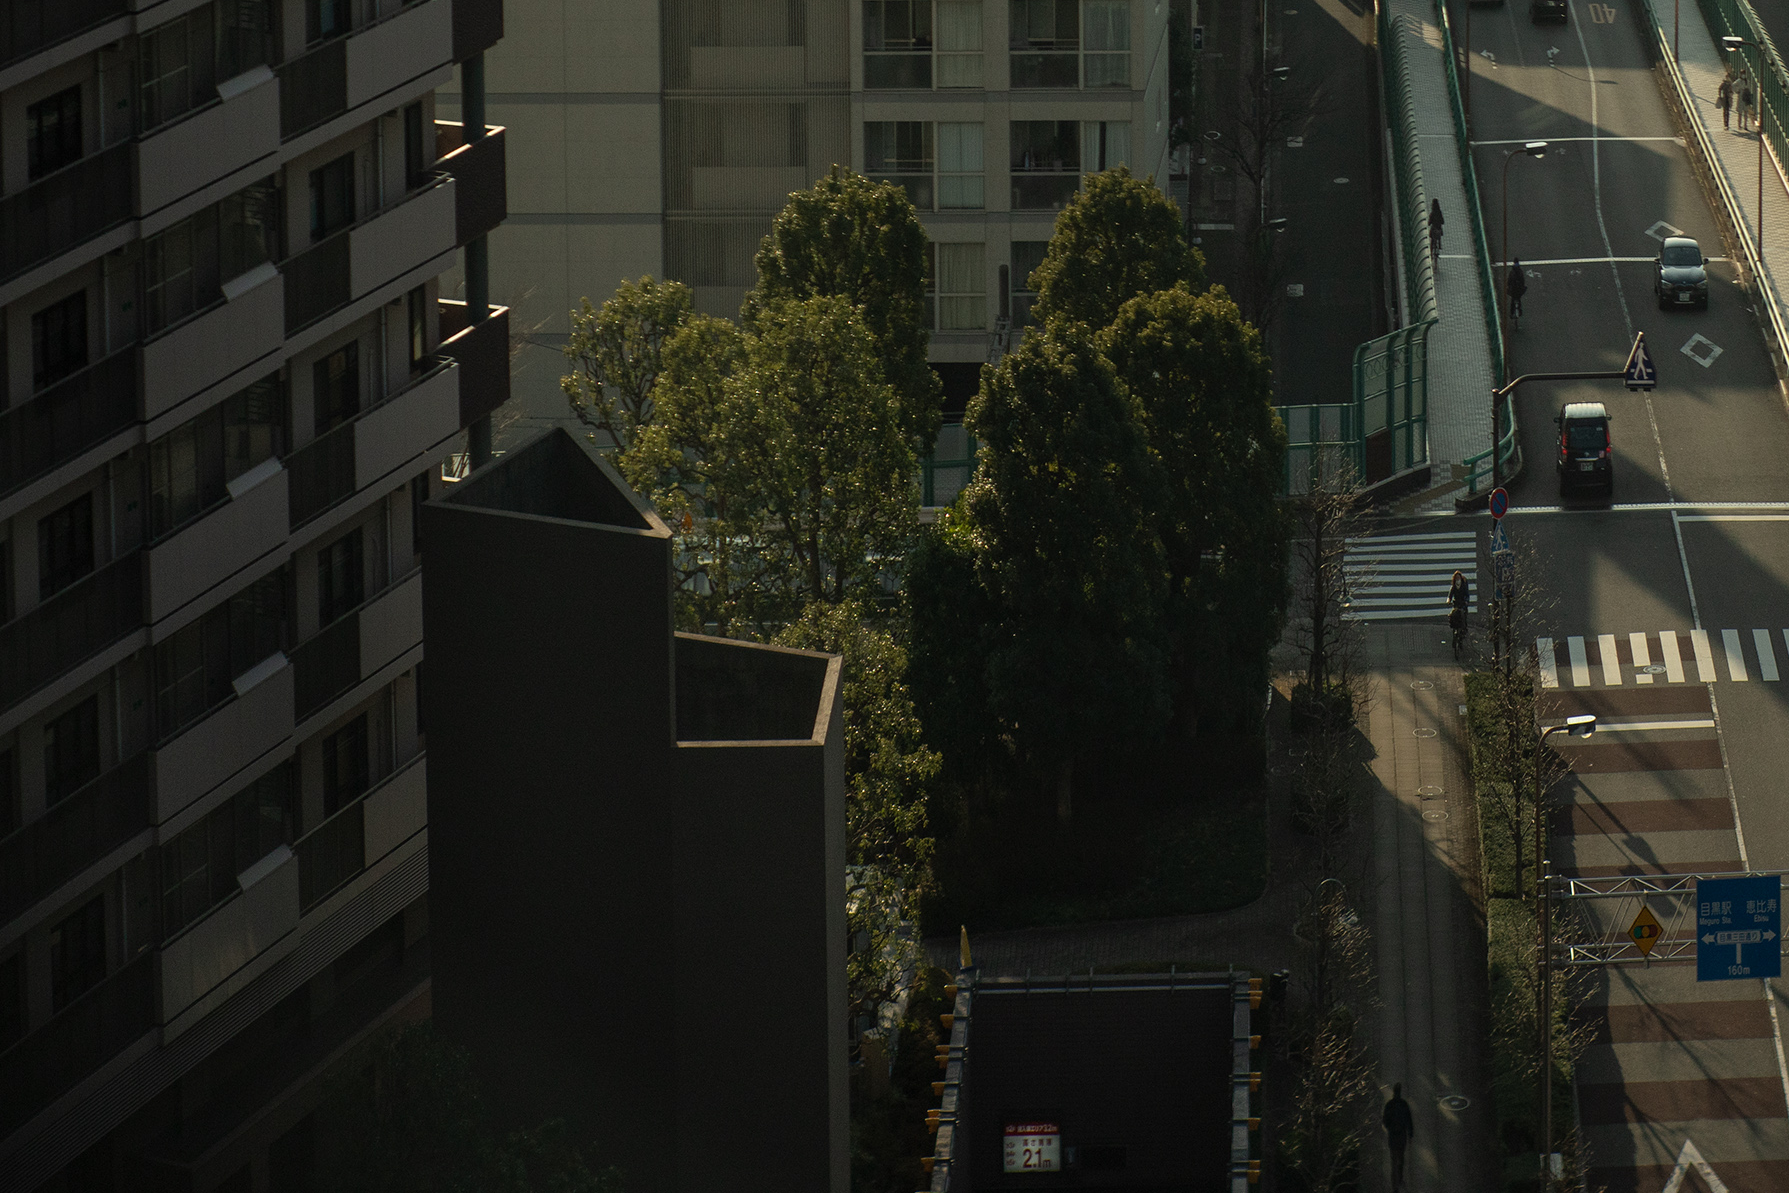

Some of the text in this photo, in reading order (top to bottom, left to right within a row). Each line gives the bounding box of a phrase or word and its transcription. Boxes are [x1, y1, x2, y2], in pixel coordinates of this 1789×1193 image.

[1700, 898, 1777, 917] 目黒駅 恵比寿
[1699, 914, 1769, 926] Meguro Sta. Ebisu
[1727, 965, 1751, 976] 160m
[1022, 1148, 1052, 1168] 2.1m
